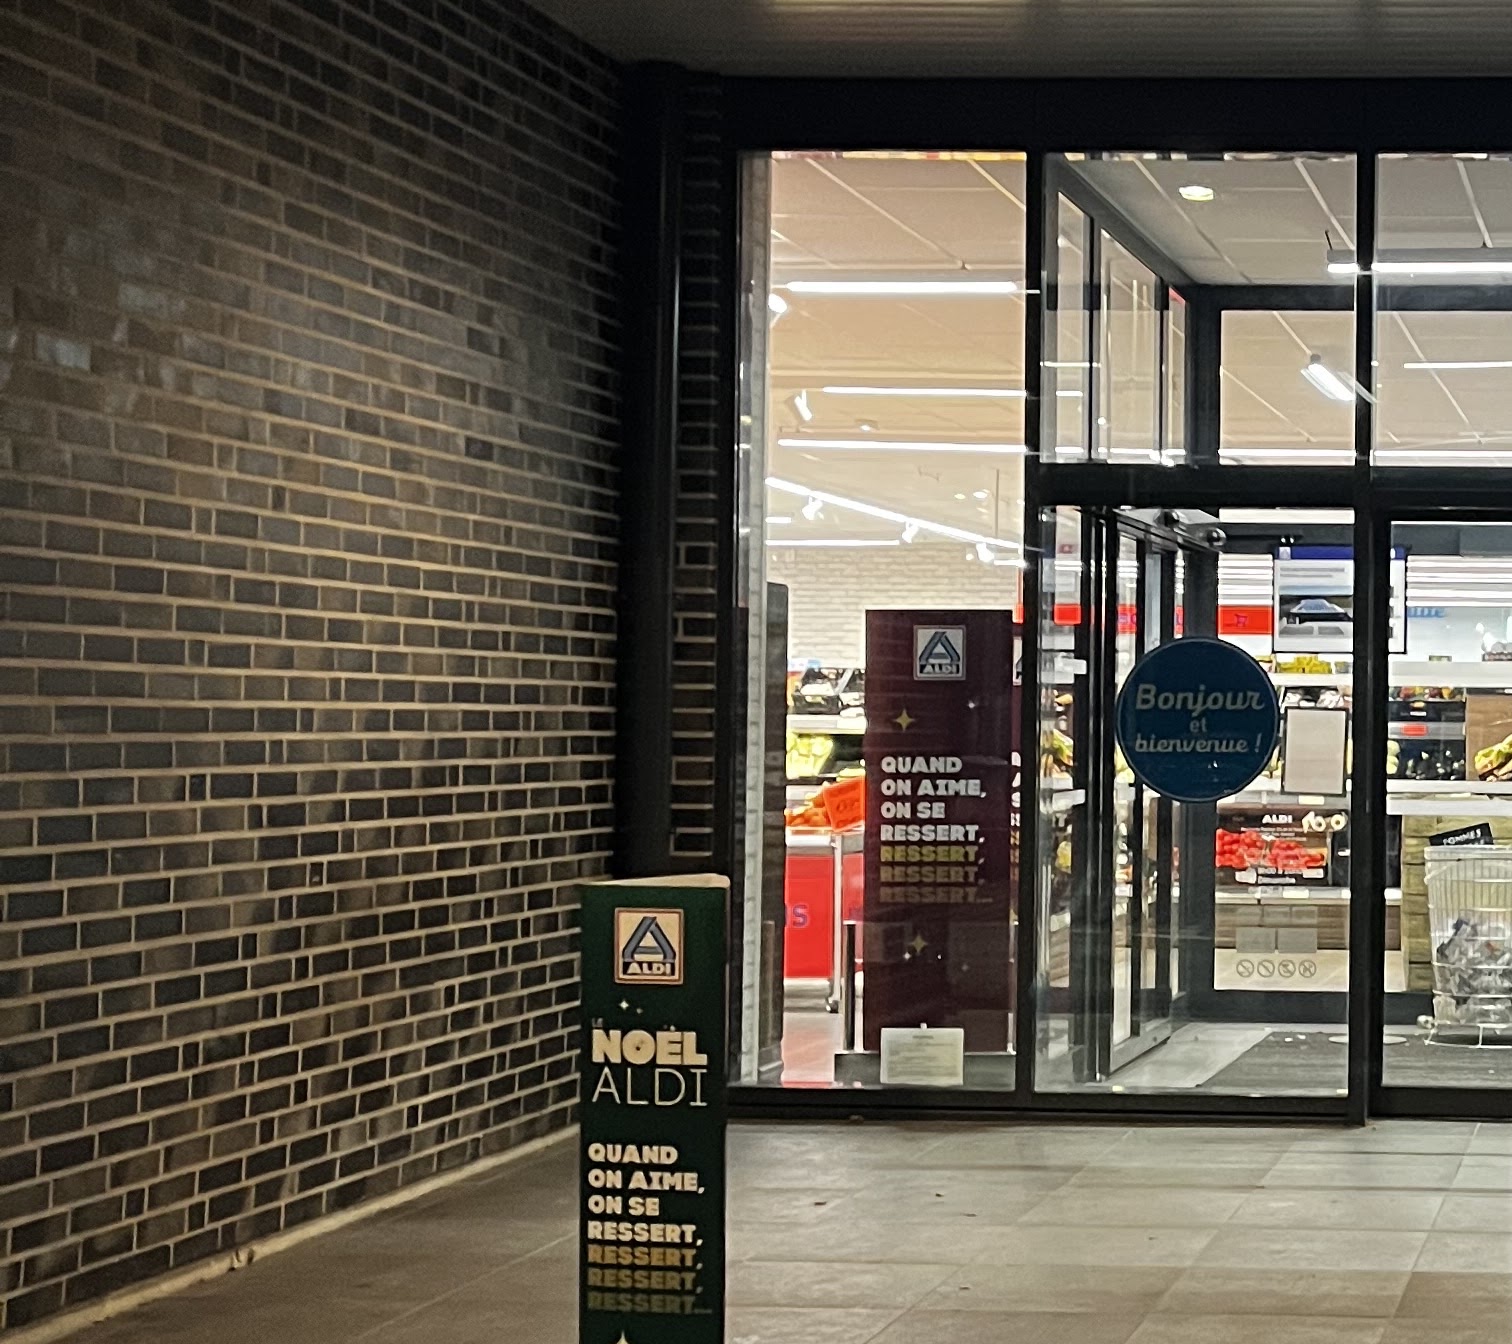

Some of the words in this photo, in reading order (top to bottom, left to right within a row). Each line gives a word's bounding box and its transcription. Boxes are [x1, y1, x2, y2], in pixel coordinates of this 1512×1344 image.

[922, 665, 957, 674] ALDI
[1135, 683, 1265, 718] Bonjour
[1190, 717, 1207, 733] et
[1135, 733, 1249, 753] bienvenue
[881, 756, 962, 773] QUAND
[881, 779, 911, 796] ON
[917, 779, 987, 798] AIME,
[881, 802, 911, 819] ON
[916, 802, 946, 818] SE
[880, 825, 985, 844] RESSERT,
[880, 845, 985, 865] RESSERT,
[880, 866, 985, 885] RESSERT,
[626, 963, 672, 975] ALDI
[592, 1066, 707, 1106] ALDI
[588, 1143, 678, 1164] QUAND
[588, 1169, 622, 1189] ON
[628, 1171, 705, 1194] AIME,
[588, 1195, 622, 1215] ON
[628, 1197, 659, 1216] SE
[588, 1220, 703, 1246] RESSERT,
[588, 1244, 703, 1270] RESSERT,
[588, 1268, 703, 1294] RESSERT,
